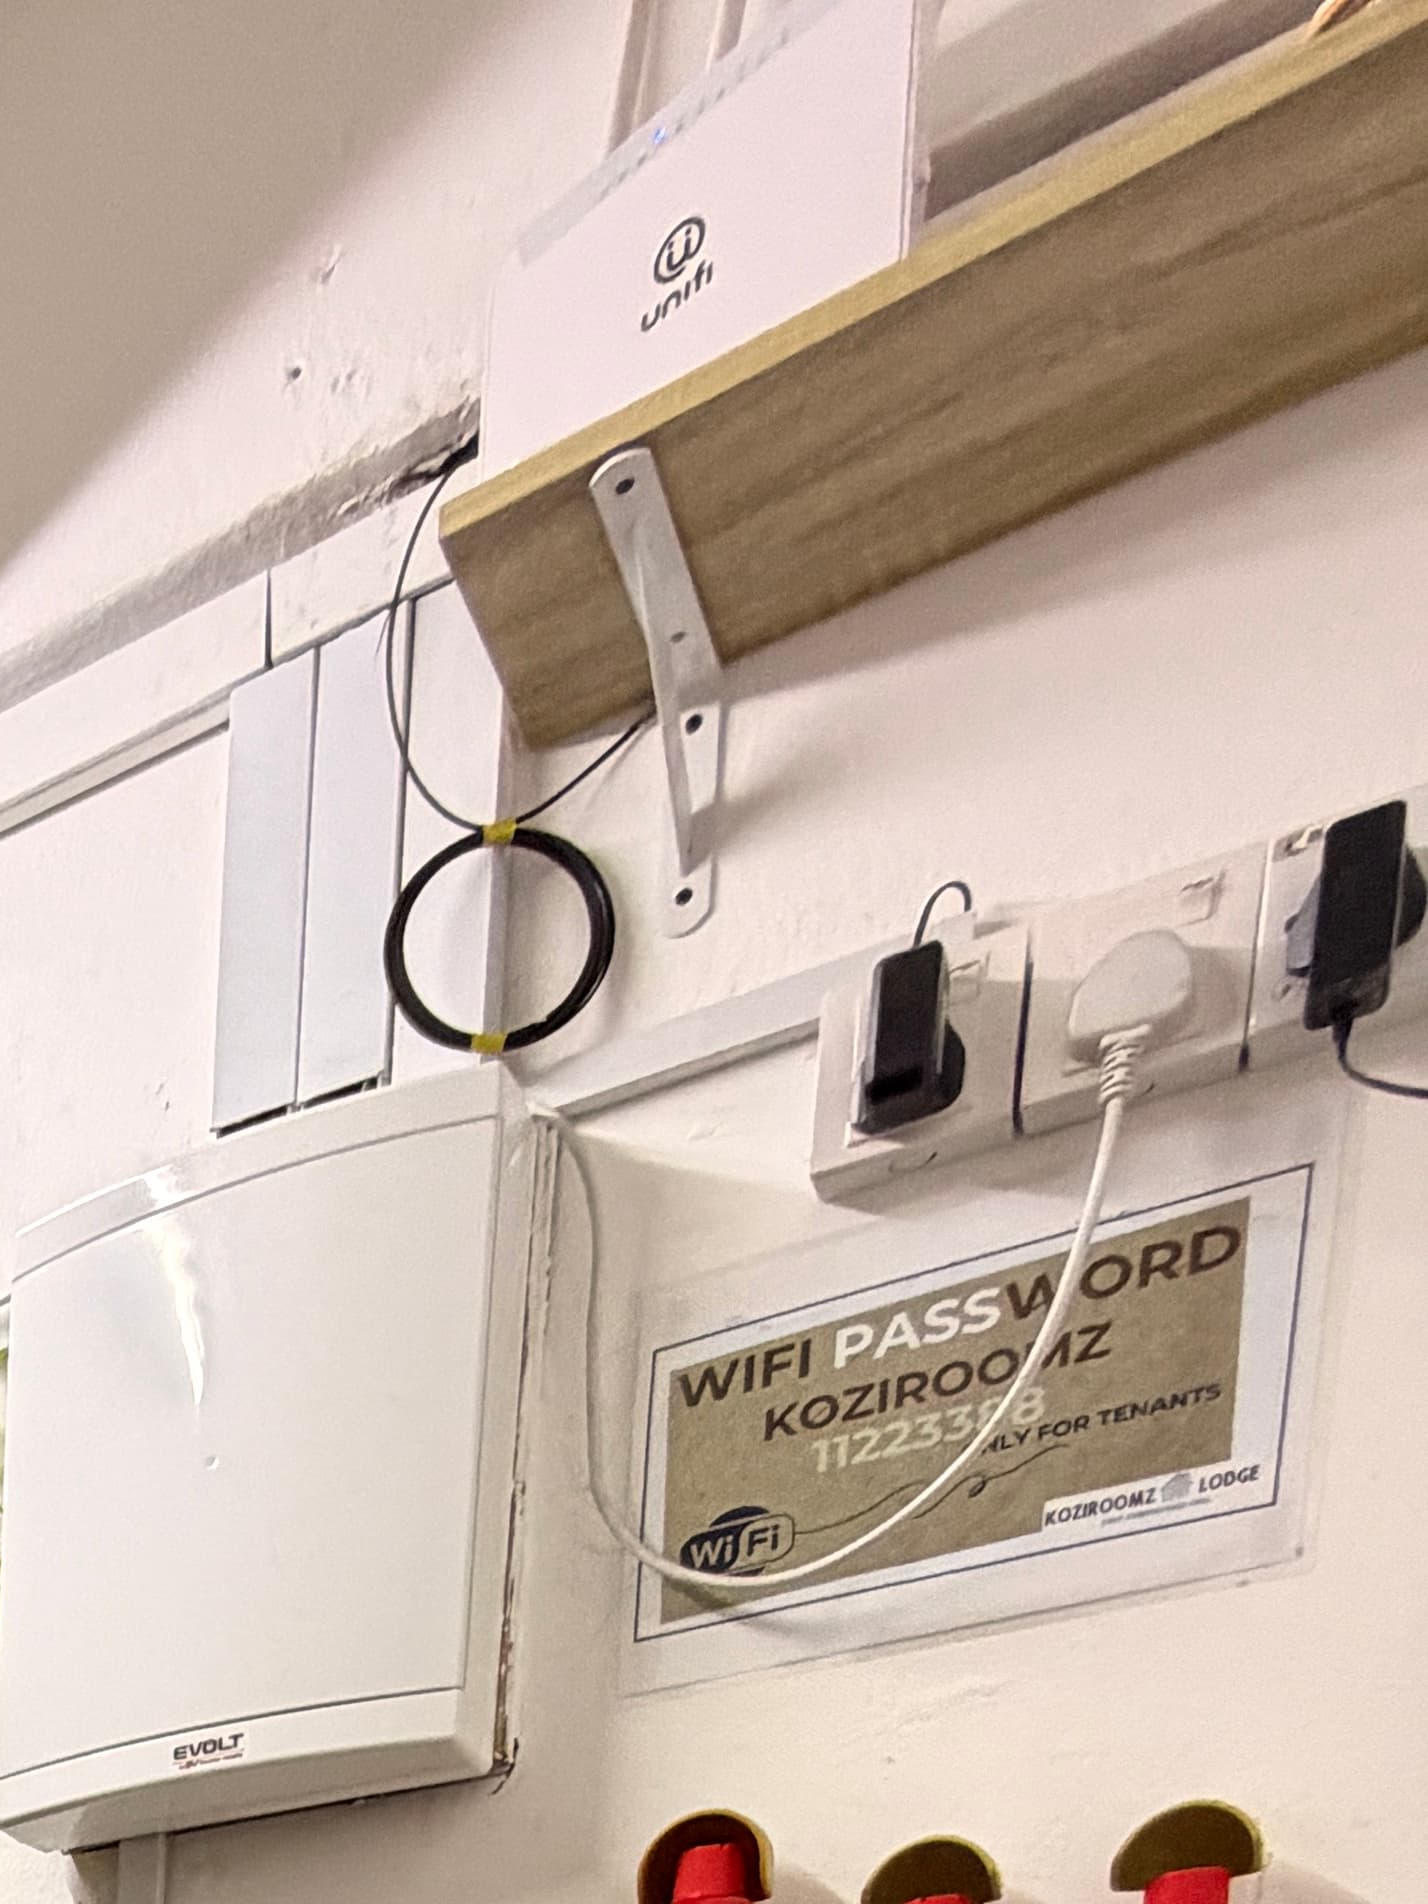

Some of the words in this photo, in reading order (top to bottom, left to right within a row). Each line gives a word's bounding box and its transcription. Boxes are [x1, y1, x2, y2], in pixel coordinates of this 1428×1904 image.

[640, 259, 714, 332] unifi
[679, 1337, 813, 1408] WIFI
[833, 1224, 1243, 1370] PASSWORD
[961, 1427, 1031, 1456] NLY
[1038, 1415, 1090, 1441] FOR
[1097, 1384, 1223, 1428] TENANTS
[1044, 1487, 1157, 1526] KOZIROOMZ
[1198, 1464, 1261, 1493] LODGE
[173, 1732, 245, 1760] EVOLT
